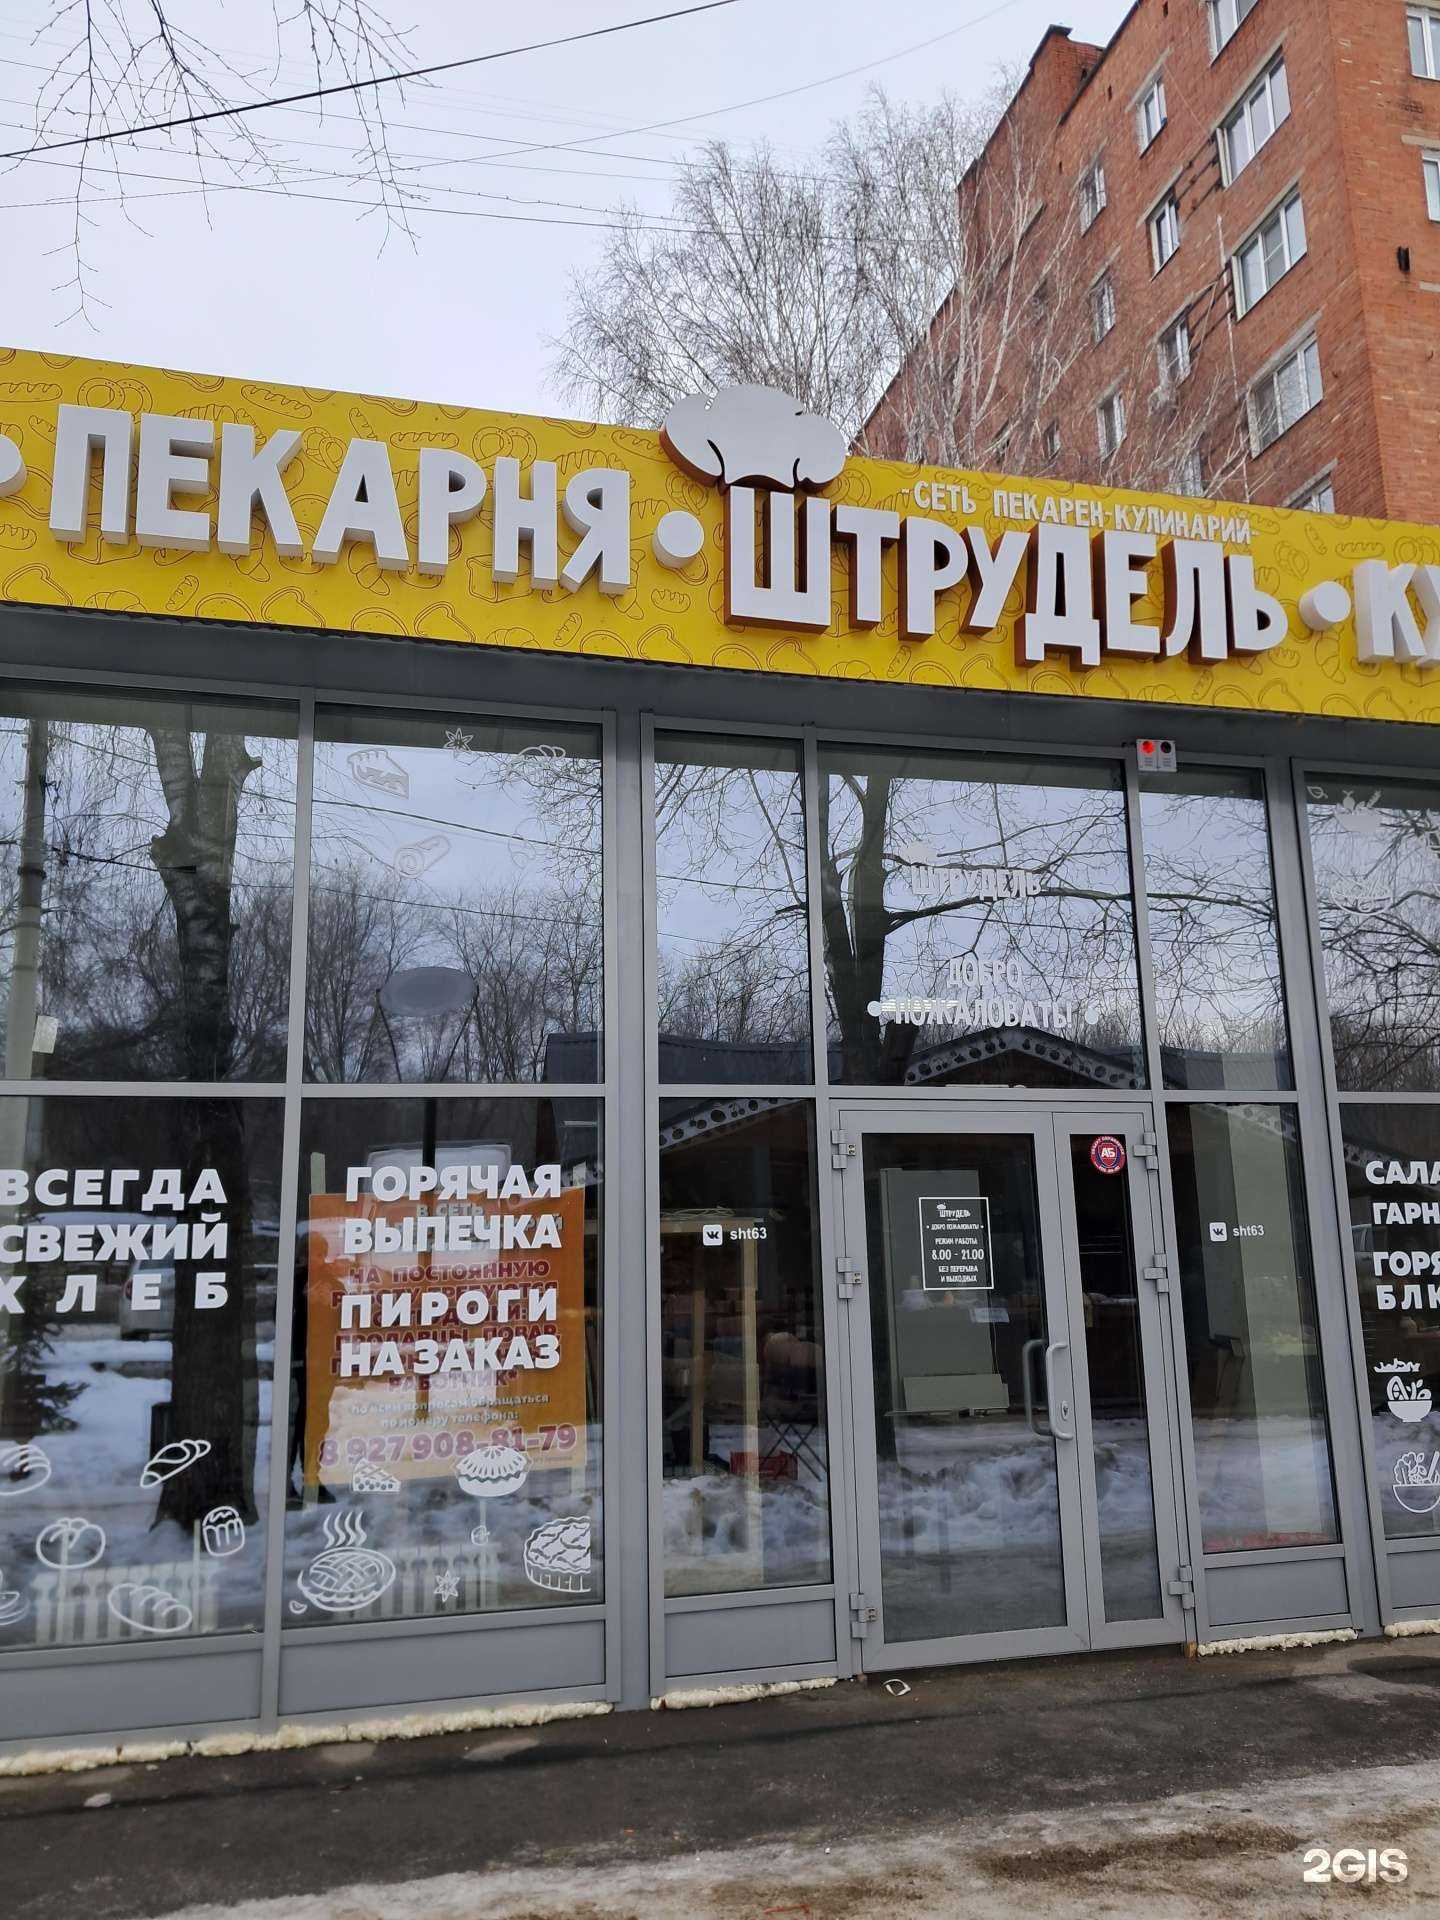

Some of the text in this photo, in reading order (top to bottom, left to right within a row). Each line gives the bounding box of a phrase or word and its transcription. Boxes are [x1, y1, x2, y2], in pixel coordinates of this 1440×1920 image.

[49, 403, 631, 594] ПЕКАРНЯ
[726, 487, 1288, 669] ШТРУДЕЛЬ
[911, 865, 1041, 900] ШТРУДЕЛЬ
[949, 958, 1023, 987] ДОБРО
[0, 1169, 228, 1211] ВСЕГДА
[345, 1165, 561, 1201] ГОРЯЧАЯ
[1233, 1225, 1264, 1236] sht63
[1373, 1203, 1440, 1225] ГАРН
[0, 1212, 228, 1263] СВЕЖИЙ
[344, 1214, 562, 1254] ВЫПЕЧКА
[730, 1227, 767, 1240] sht63
[935, 1237, 978, 1245] РЕЖИМ РАБОТЫ
[392, 1260, 551, 1283] ПОСТОЯННУЮ
[931, 1249, 952, 1260] 8.00
[961, 1249, 984, 1260] 21.00
[938, 1265, 949, 1273] БЕЗ
[0, 1272, 228, 1315] ХЛЕБ
[340, 1288, 557, 1329] ПИРОГИ
[340, 1341, 405, 1377] НА
[413, 1335, 561, 1375] ЗАКАЗ
